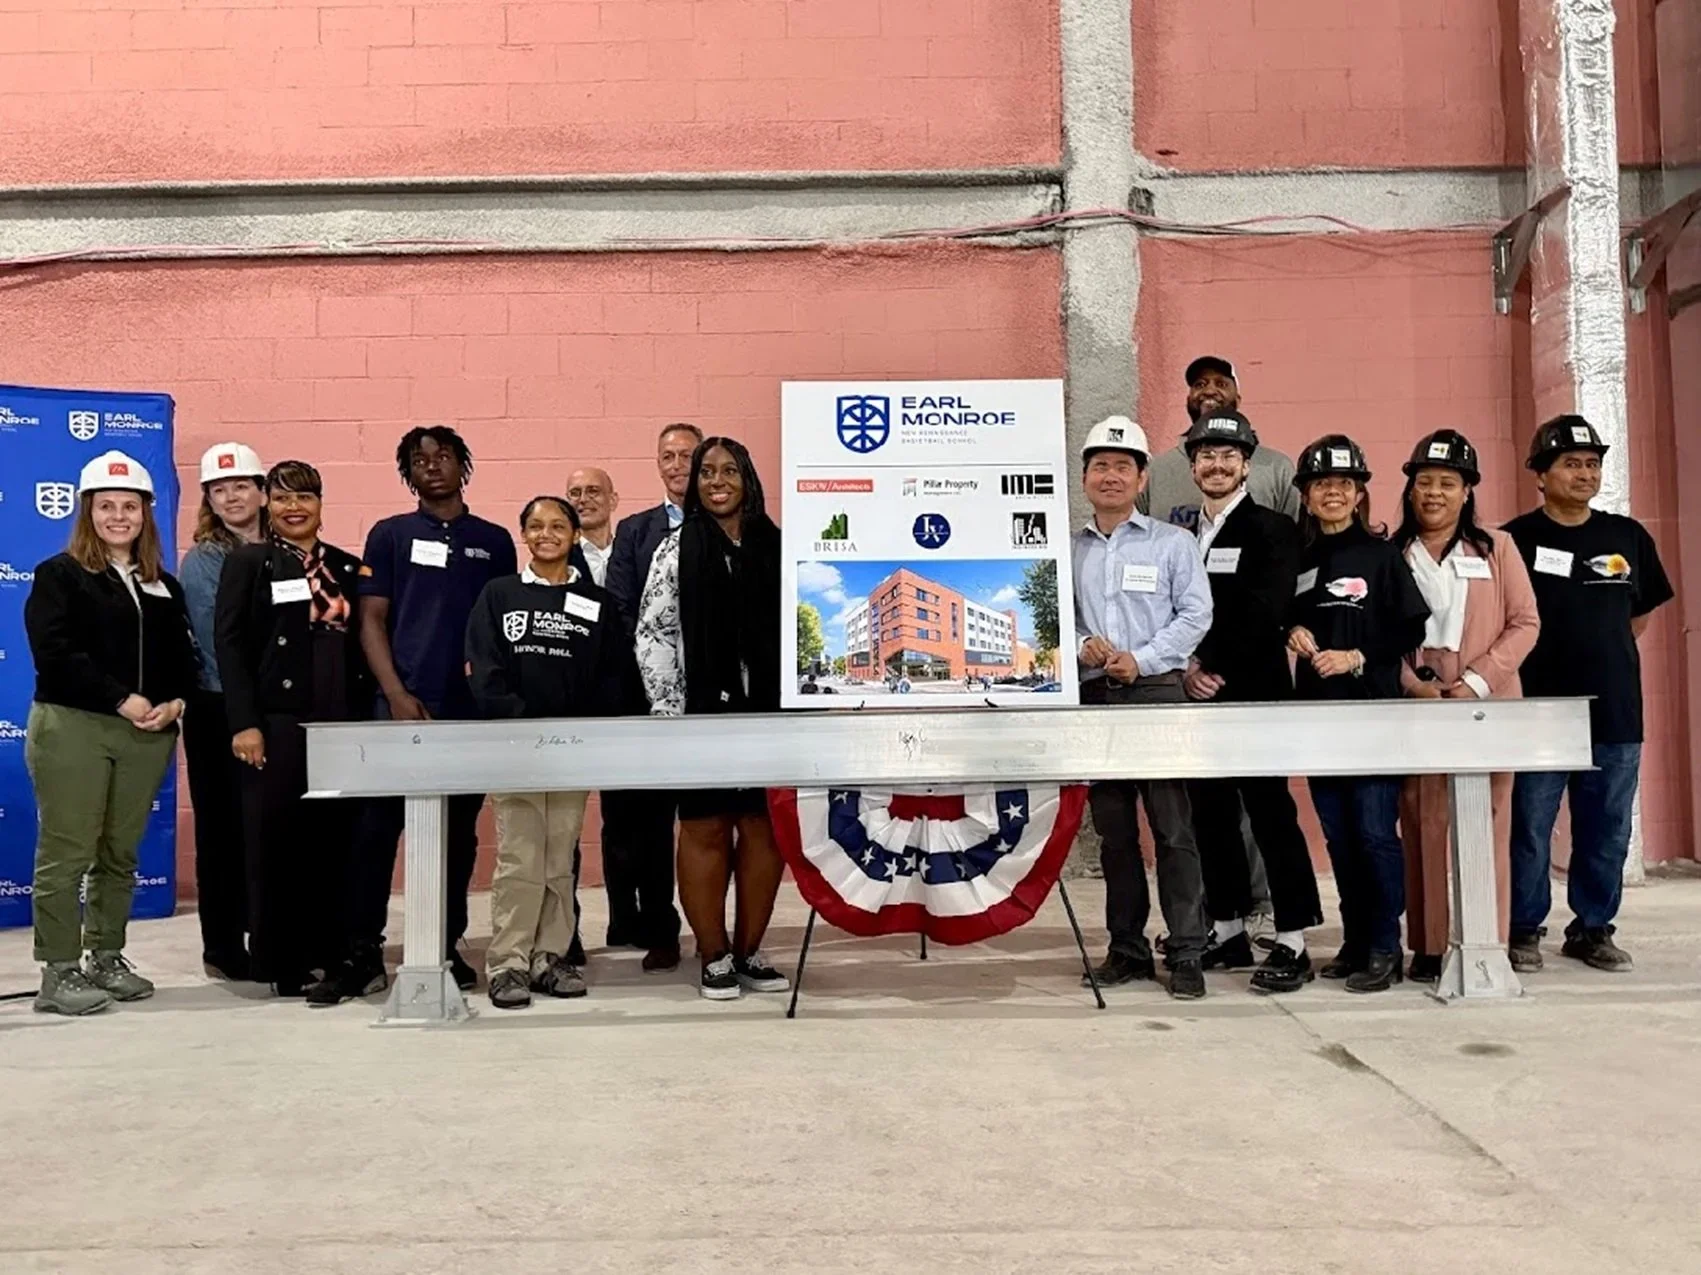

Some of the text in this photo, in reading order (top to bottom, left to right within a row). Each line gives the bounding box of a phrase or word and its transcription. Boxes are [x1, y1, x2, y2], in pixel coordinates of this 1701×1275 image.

[901, 396, 971, 409] EARL
[104, 413, 142, 423] EARL
[901, 411, 1015, 426] MONROE
[104, 421, 163, 430] MONROE
[814, 542, 858, 552] BRISA
[534, 610, 571, 623] EARL
[533, 620, 590, 636] MONROE
